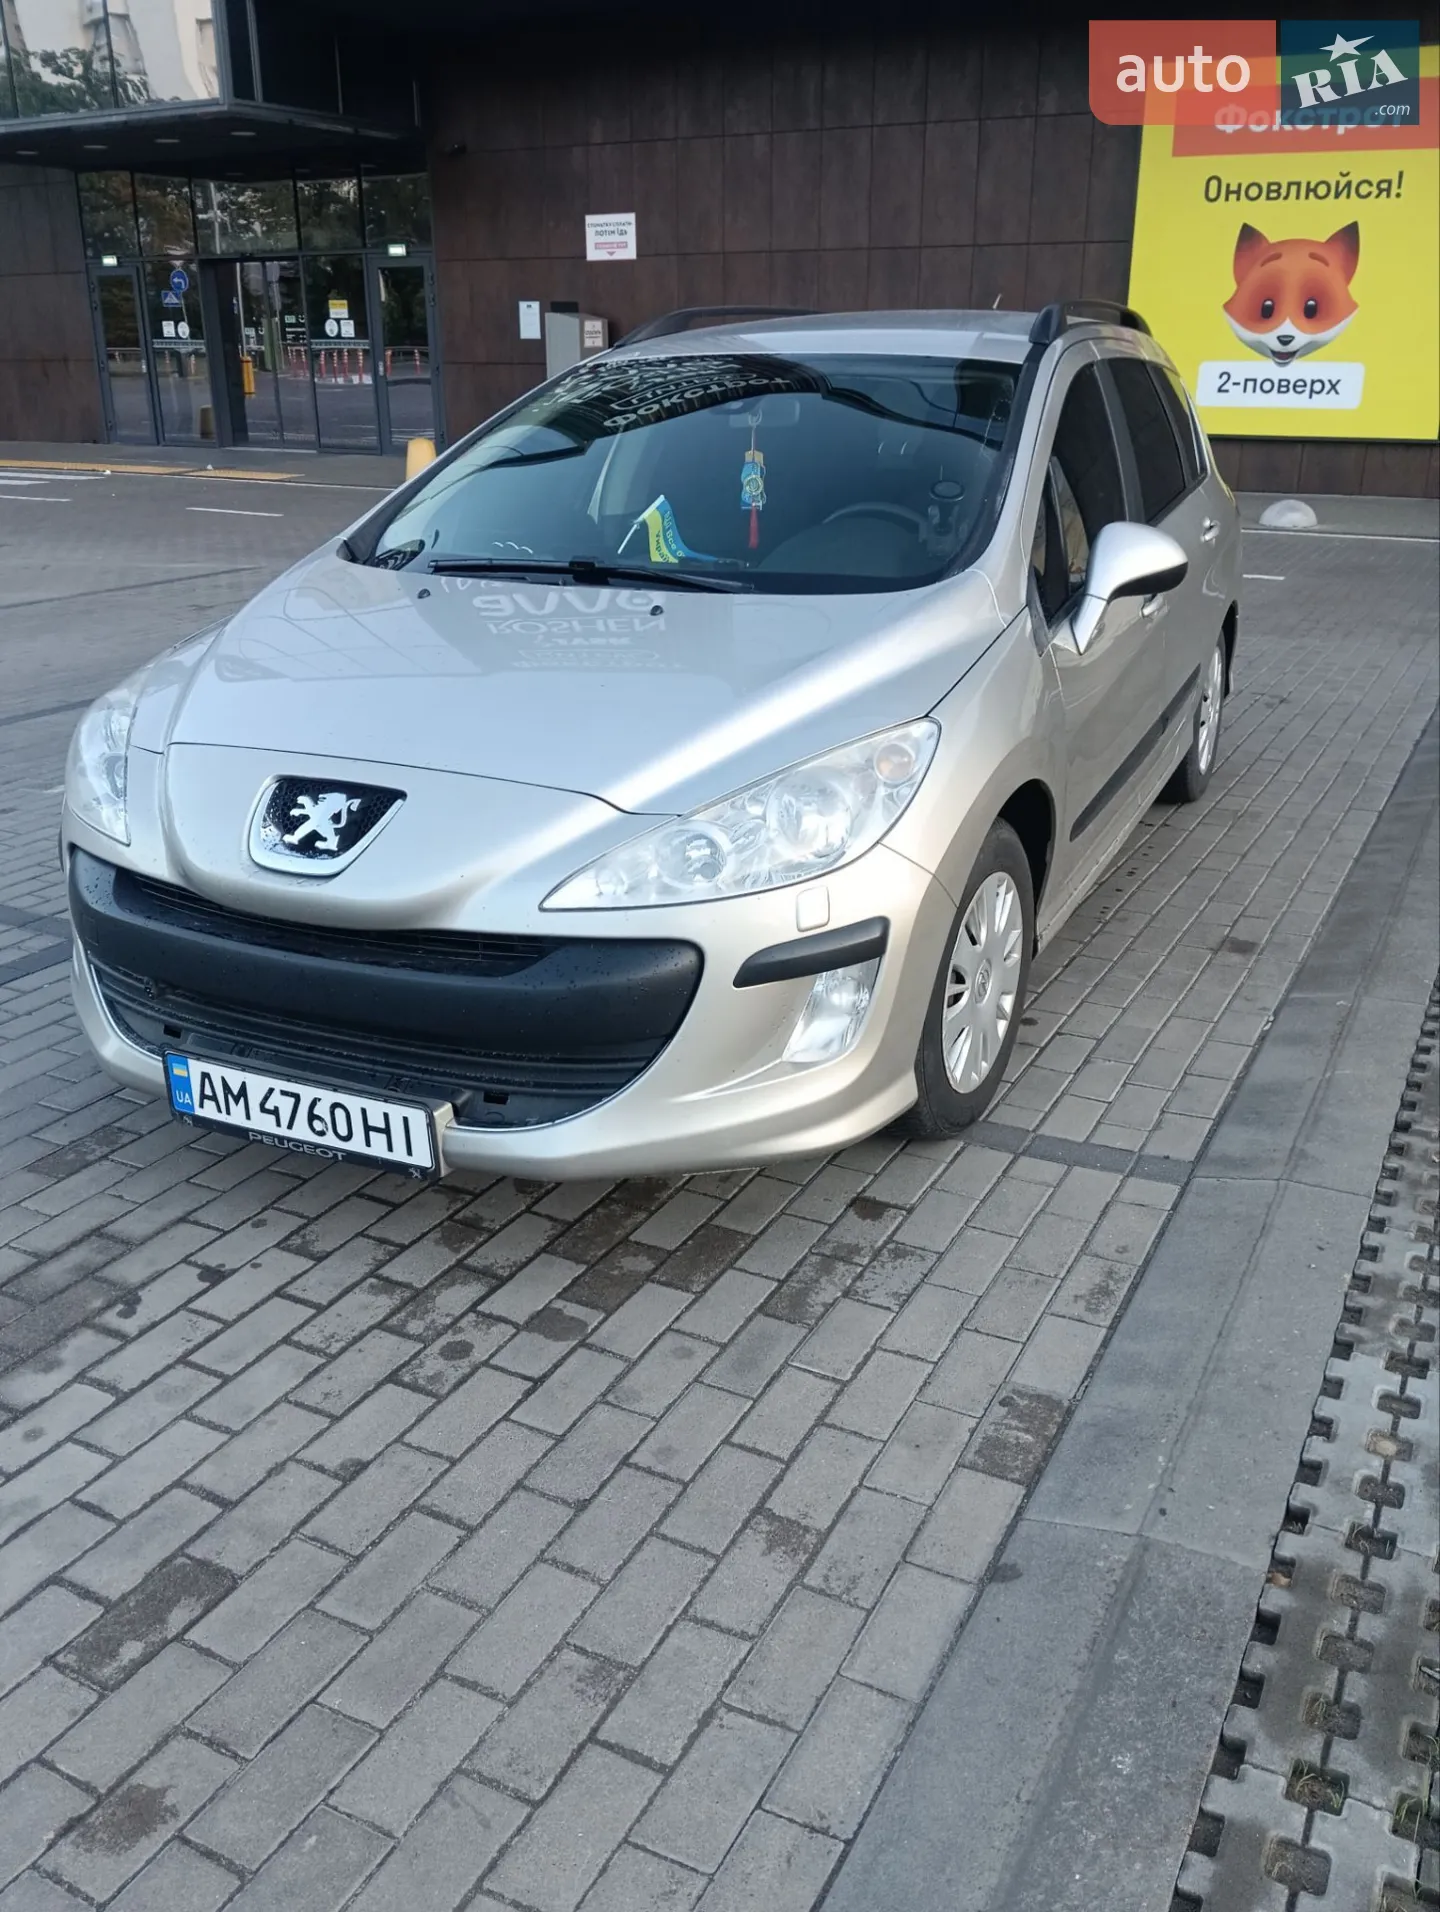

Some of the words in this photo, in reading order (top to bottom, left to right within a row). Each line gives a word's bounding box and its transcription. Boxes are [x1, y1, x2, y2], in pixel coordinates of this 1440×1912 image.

[1204, 171, 1404, 203] Оновлюйся!
[1217, 372, 1340, 398] 2-поверх
[176, 1091, 192, 1105] UA
[249, 1132, 347, 1161] PEUGEOT
